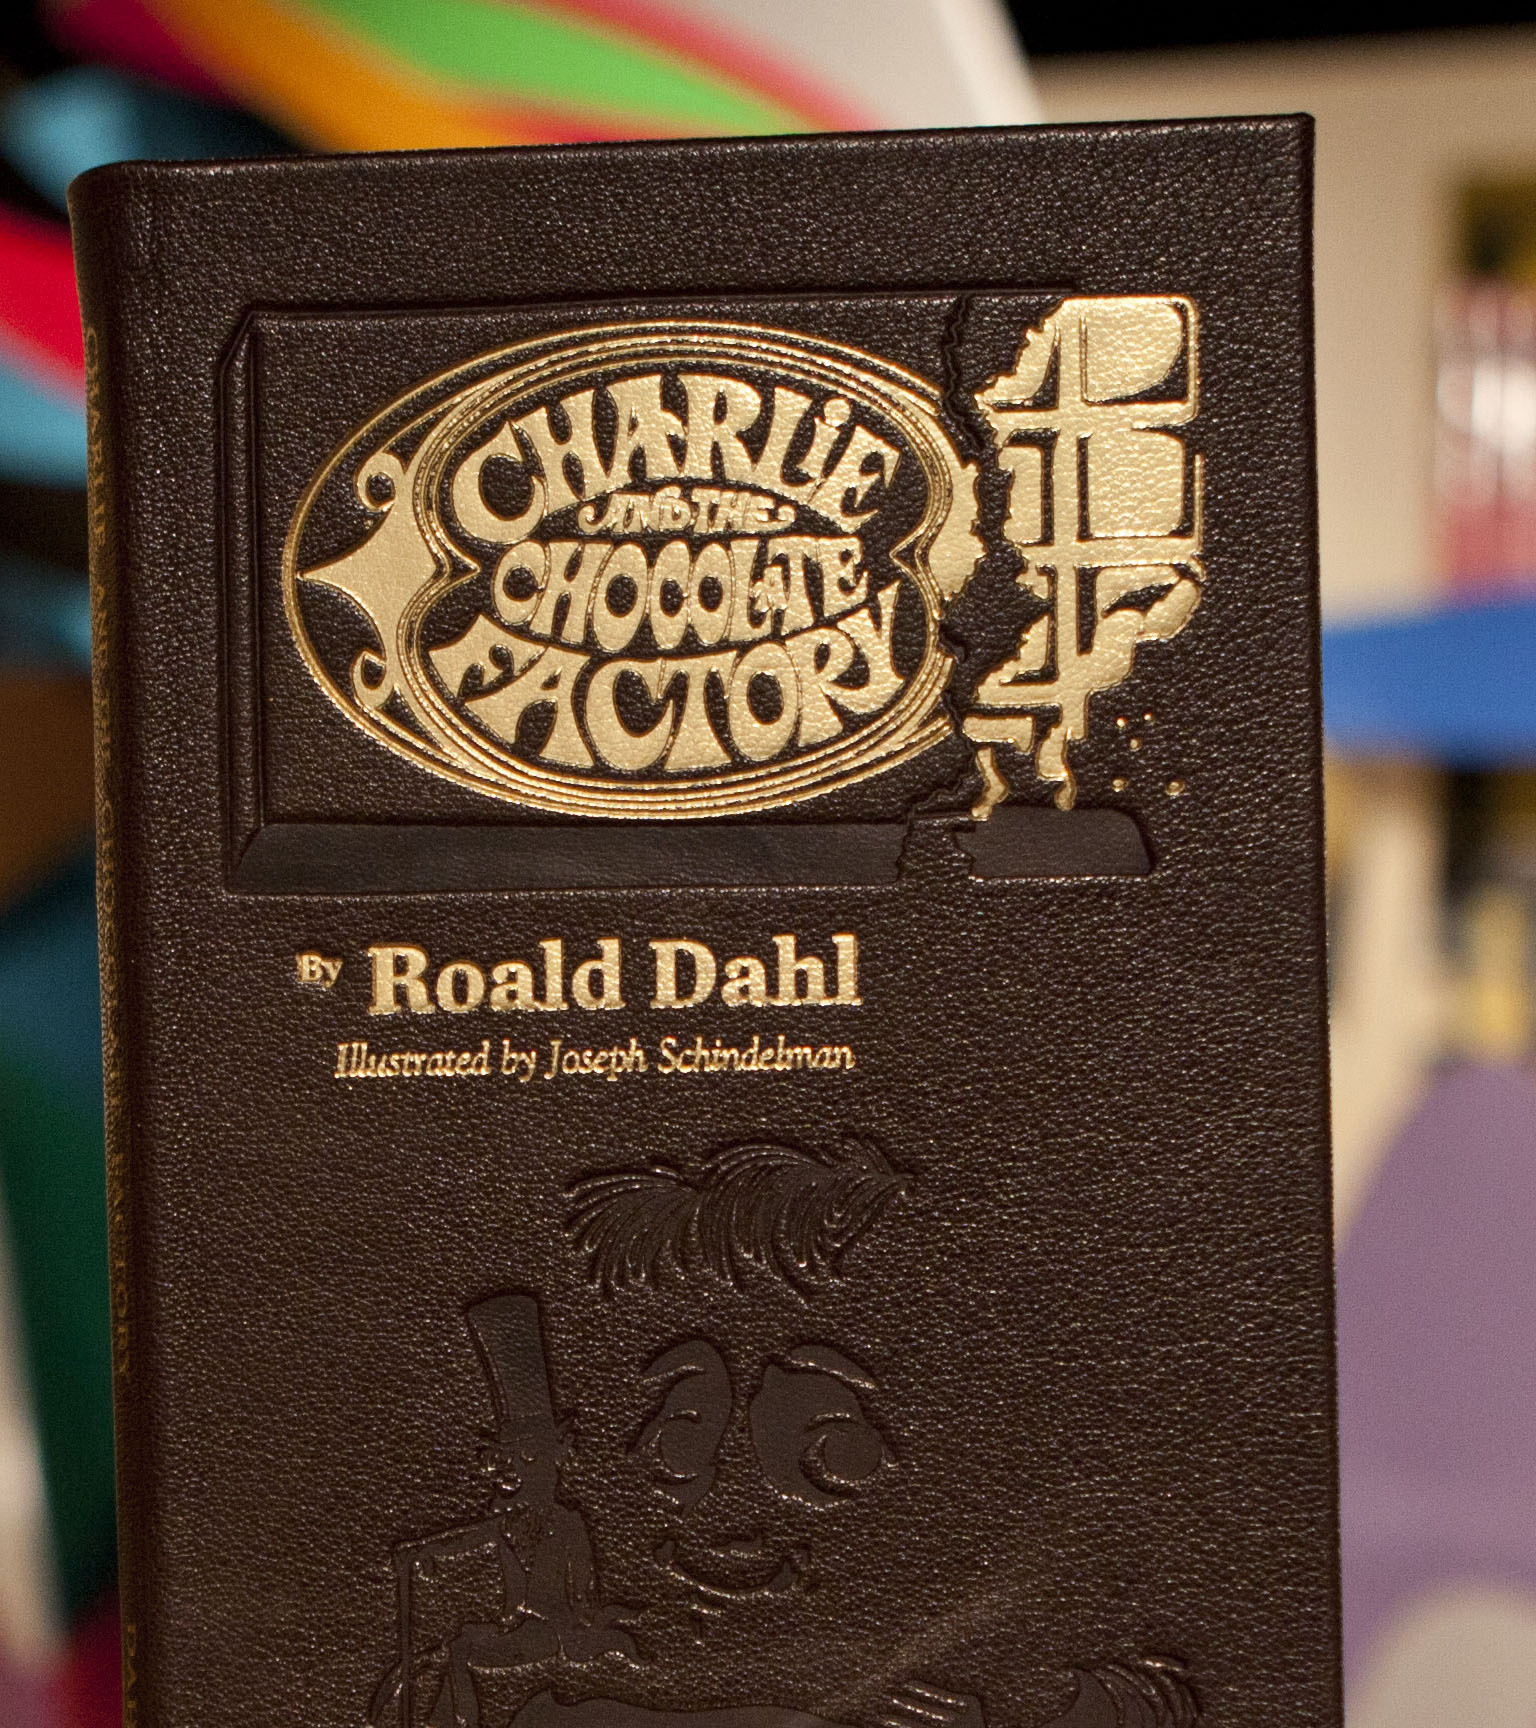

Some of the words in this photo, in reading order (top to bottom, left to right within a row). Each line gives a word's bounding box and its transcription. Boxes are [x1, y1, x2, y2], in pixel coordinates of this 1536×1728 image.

[578, 486, 691, 535] AND
[689, 487, 795, 535] THE
[492, 535, 869, 653] CHOCOLATE
[428, 581, 906, 771] FACTORY
[296, 952, 343, 988] By
[368, 938, 627, 1016] Roald
[649, 934, 863, 1010] Dahl
[334, 1040, 491, 1078] Illustrated
[501, 1039, 537, 1082] by
[544, 1039, 648, 1081] Joseph
[657, 1036, 856, 1074] Schindelman
